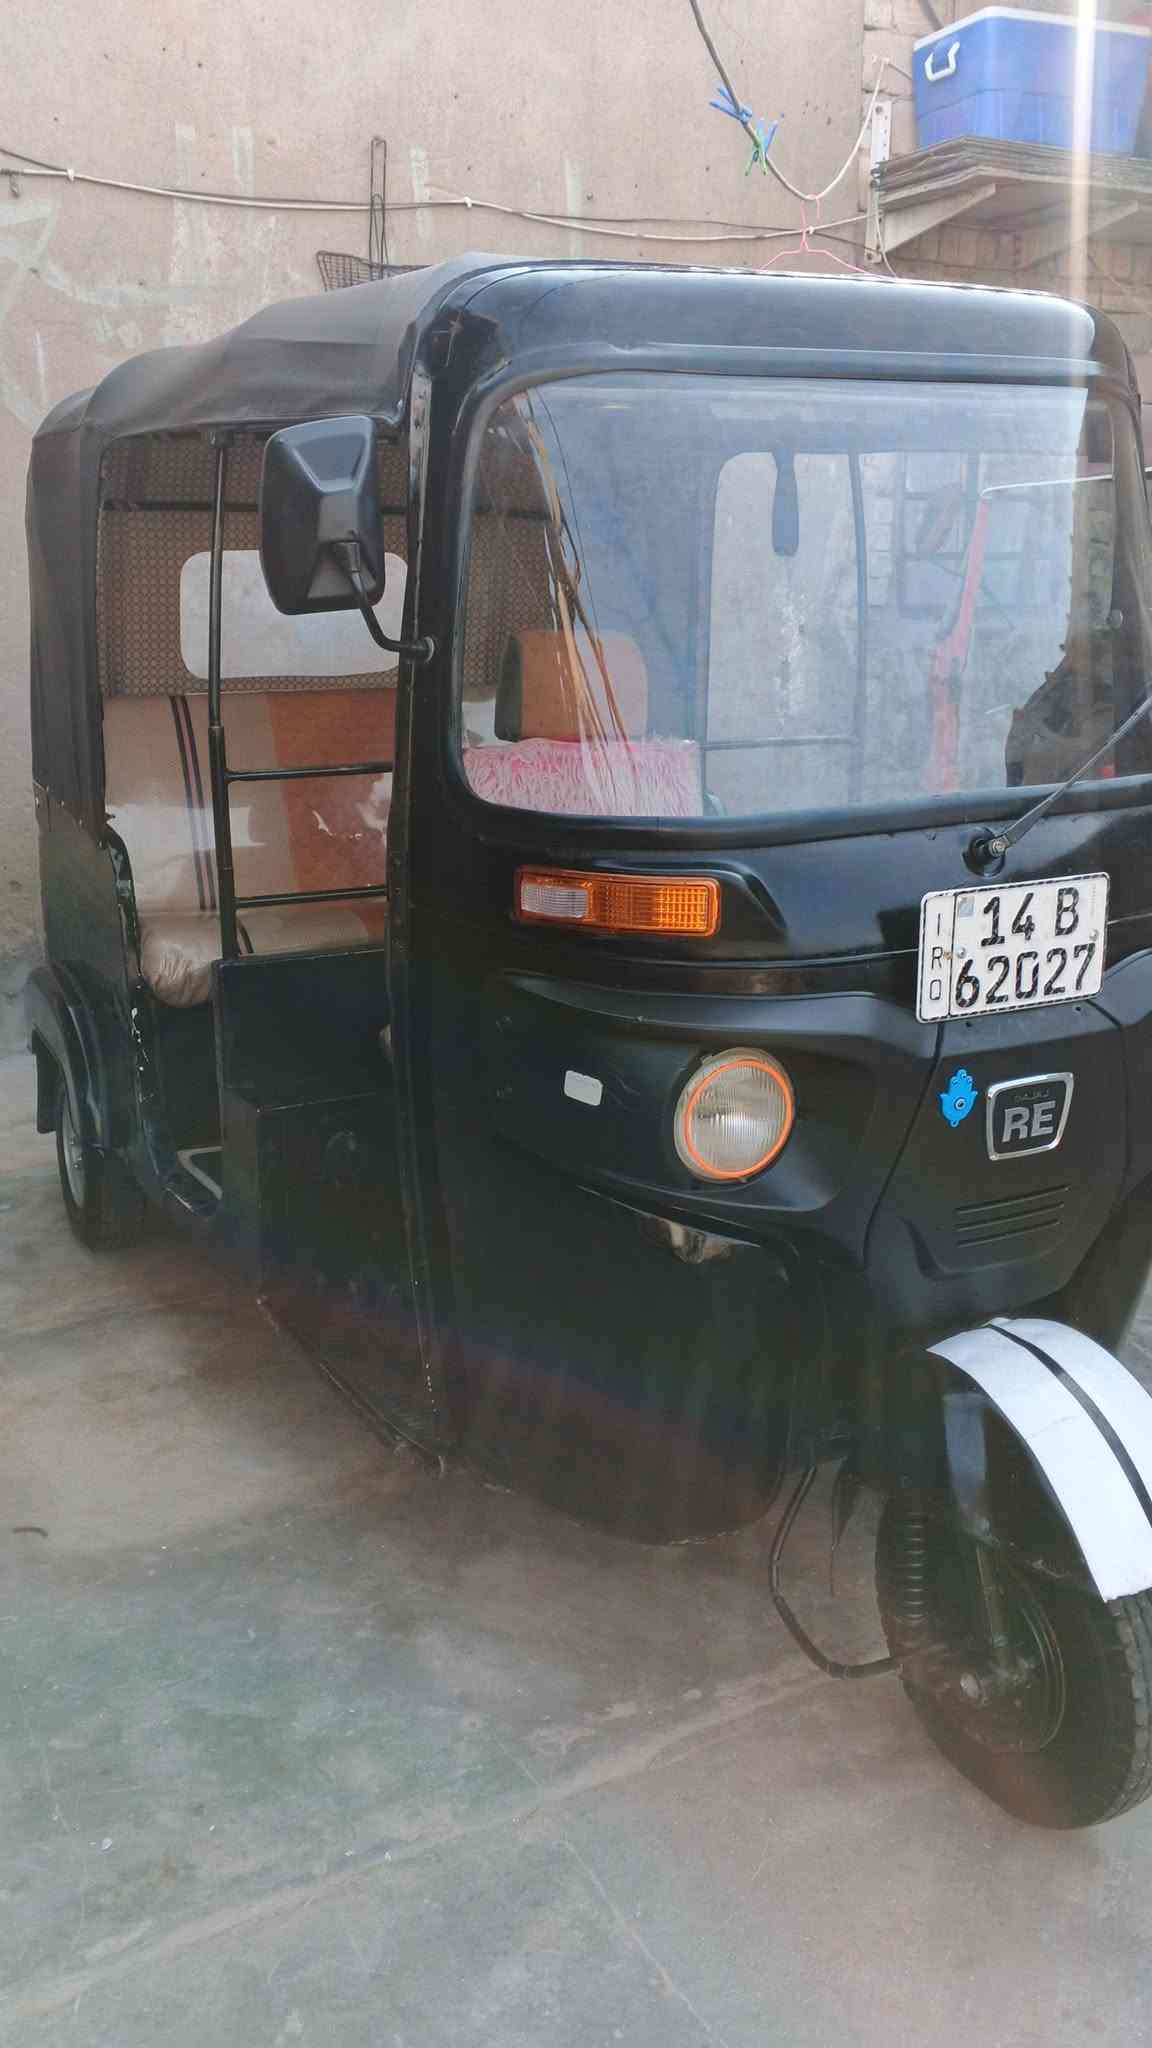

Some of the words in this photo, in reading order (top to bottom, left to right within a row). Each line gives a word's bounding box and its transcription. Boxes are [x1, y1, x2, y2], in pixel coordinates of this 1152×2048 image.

[981, 892, 1035, 947] 14
[1055, 887, 1080, 936] B
[955, 943, 1096, 1008] 62027
[1002, 1100, 1056, 1142] RE
